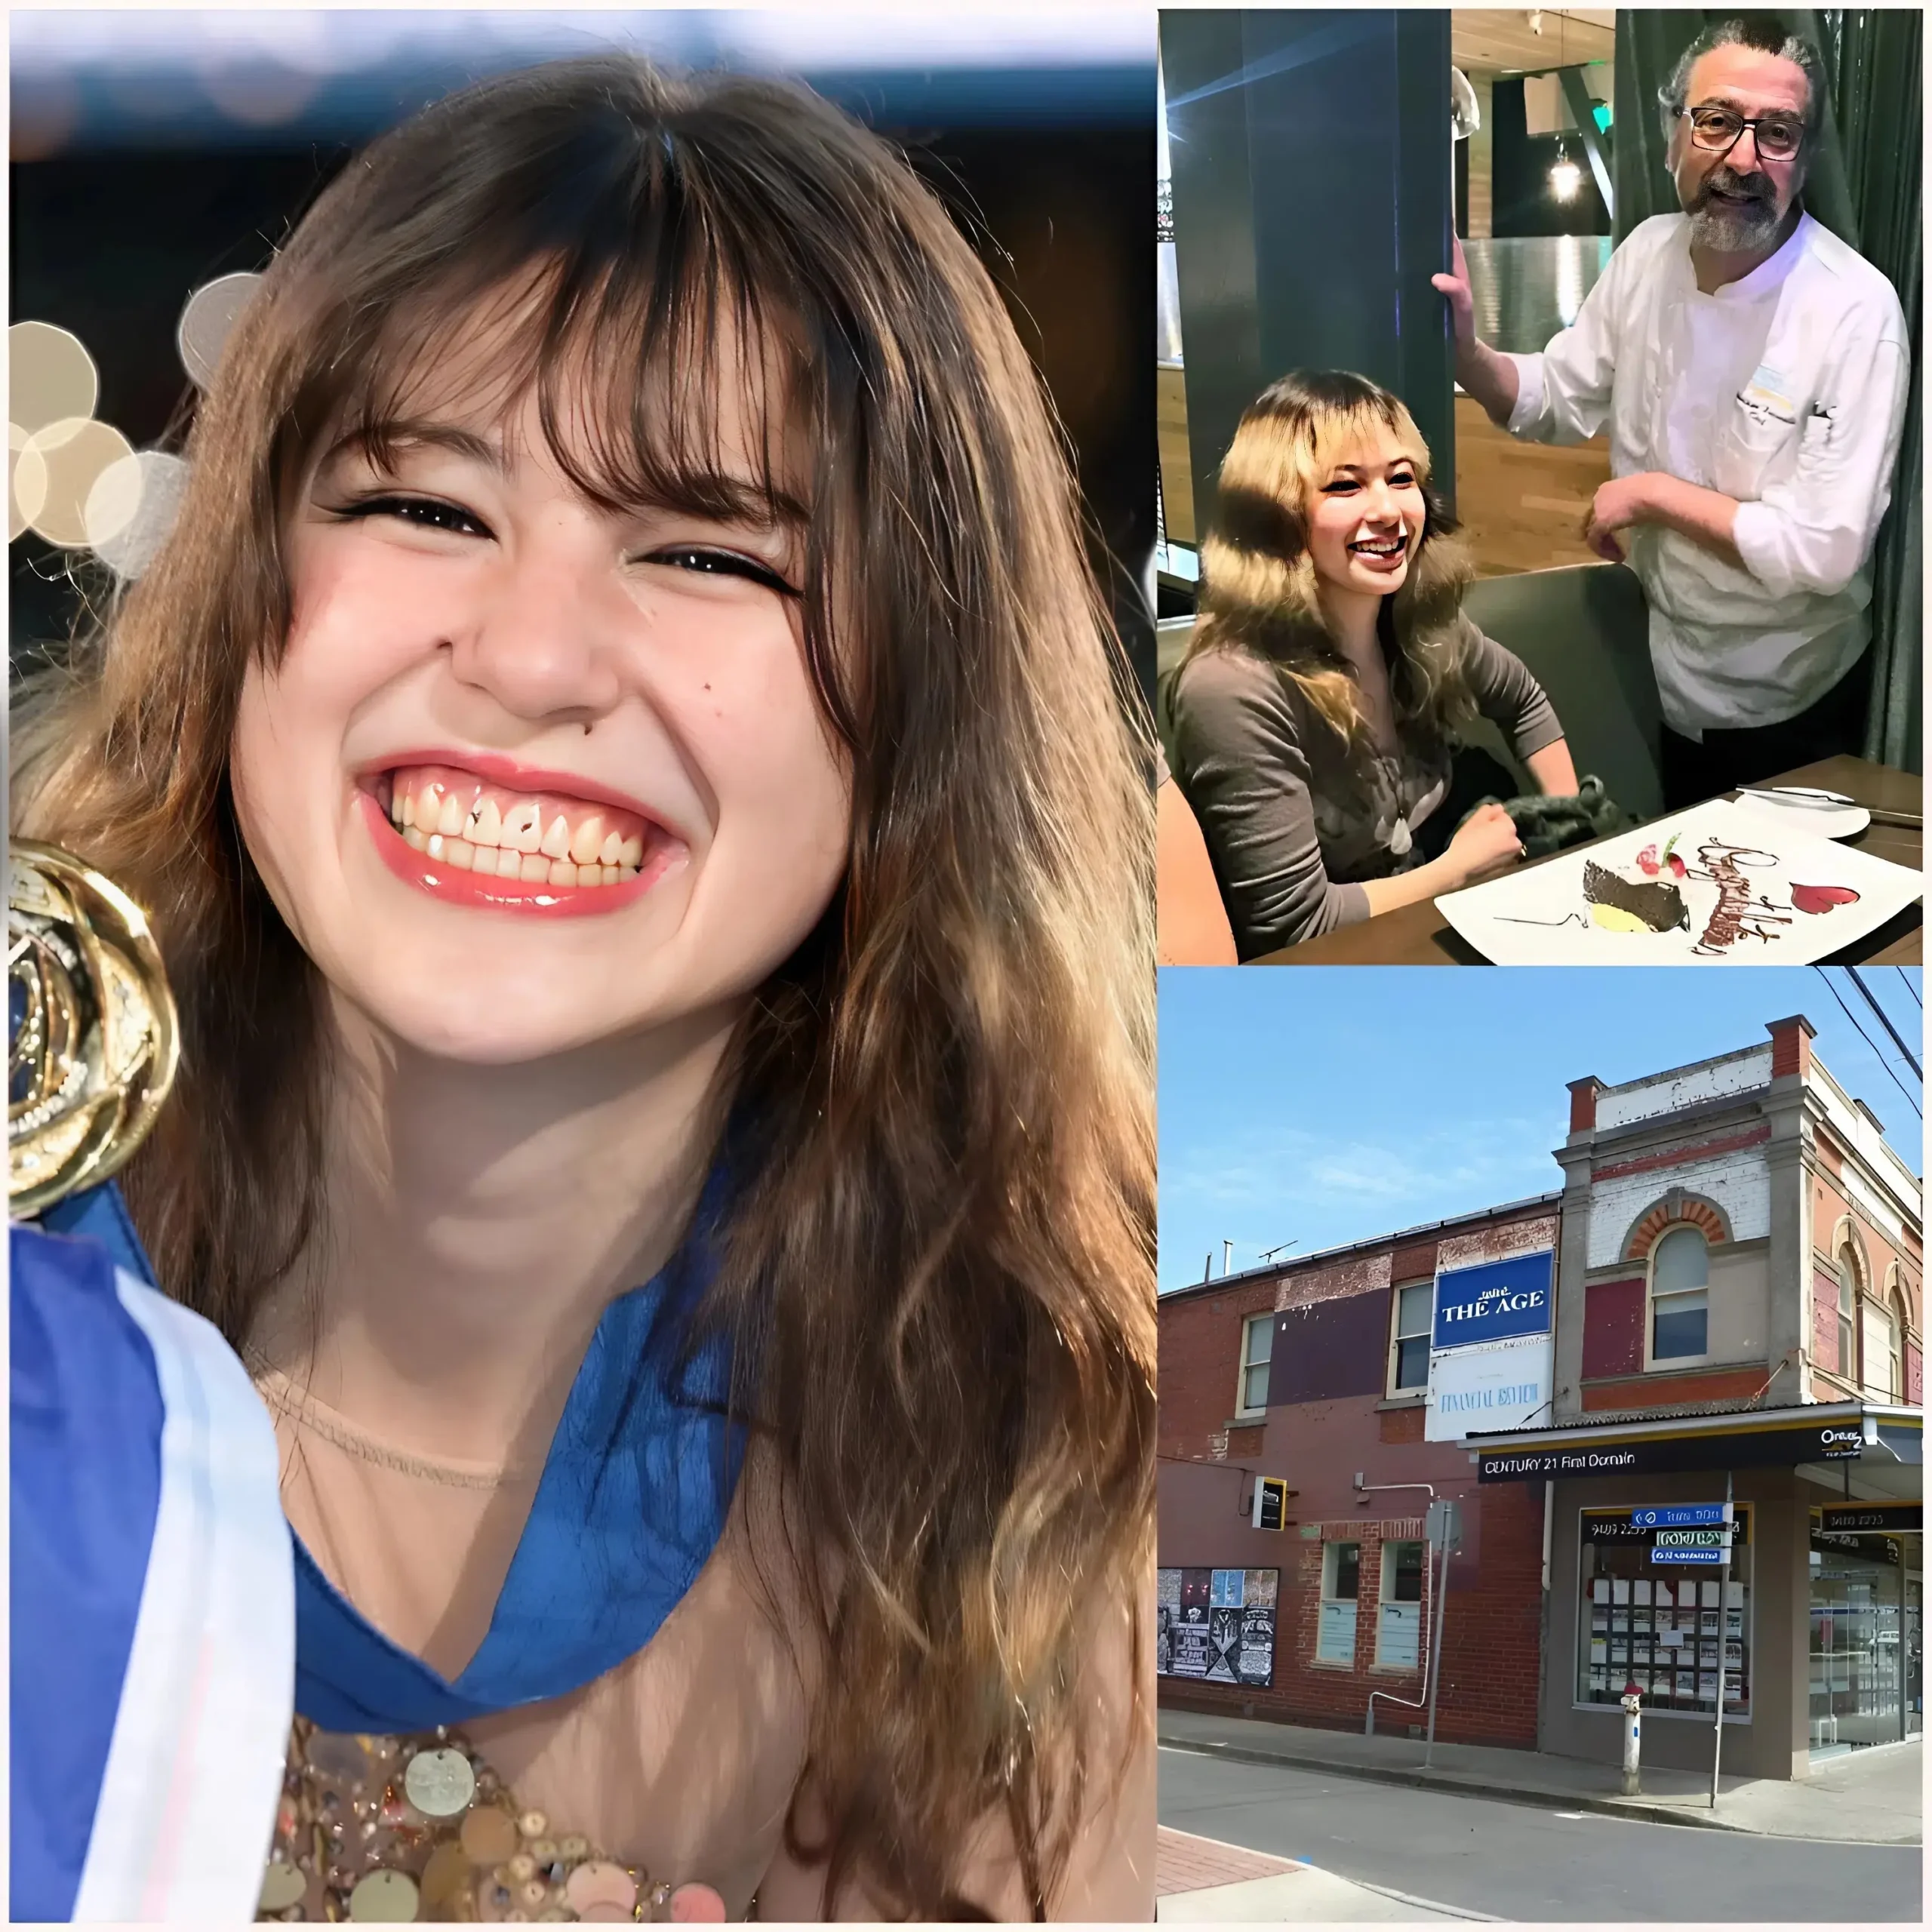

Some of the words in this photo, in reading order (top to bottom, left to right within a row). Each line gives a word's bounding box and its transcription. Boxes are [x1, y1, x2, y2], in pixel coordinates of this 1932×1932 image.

[1442, 1300, 1489, 1322] THE
[1496, 1290, 1544, 1314] AGE
[1543, 1457, 1557, 1470] 21
